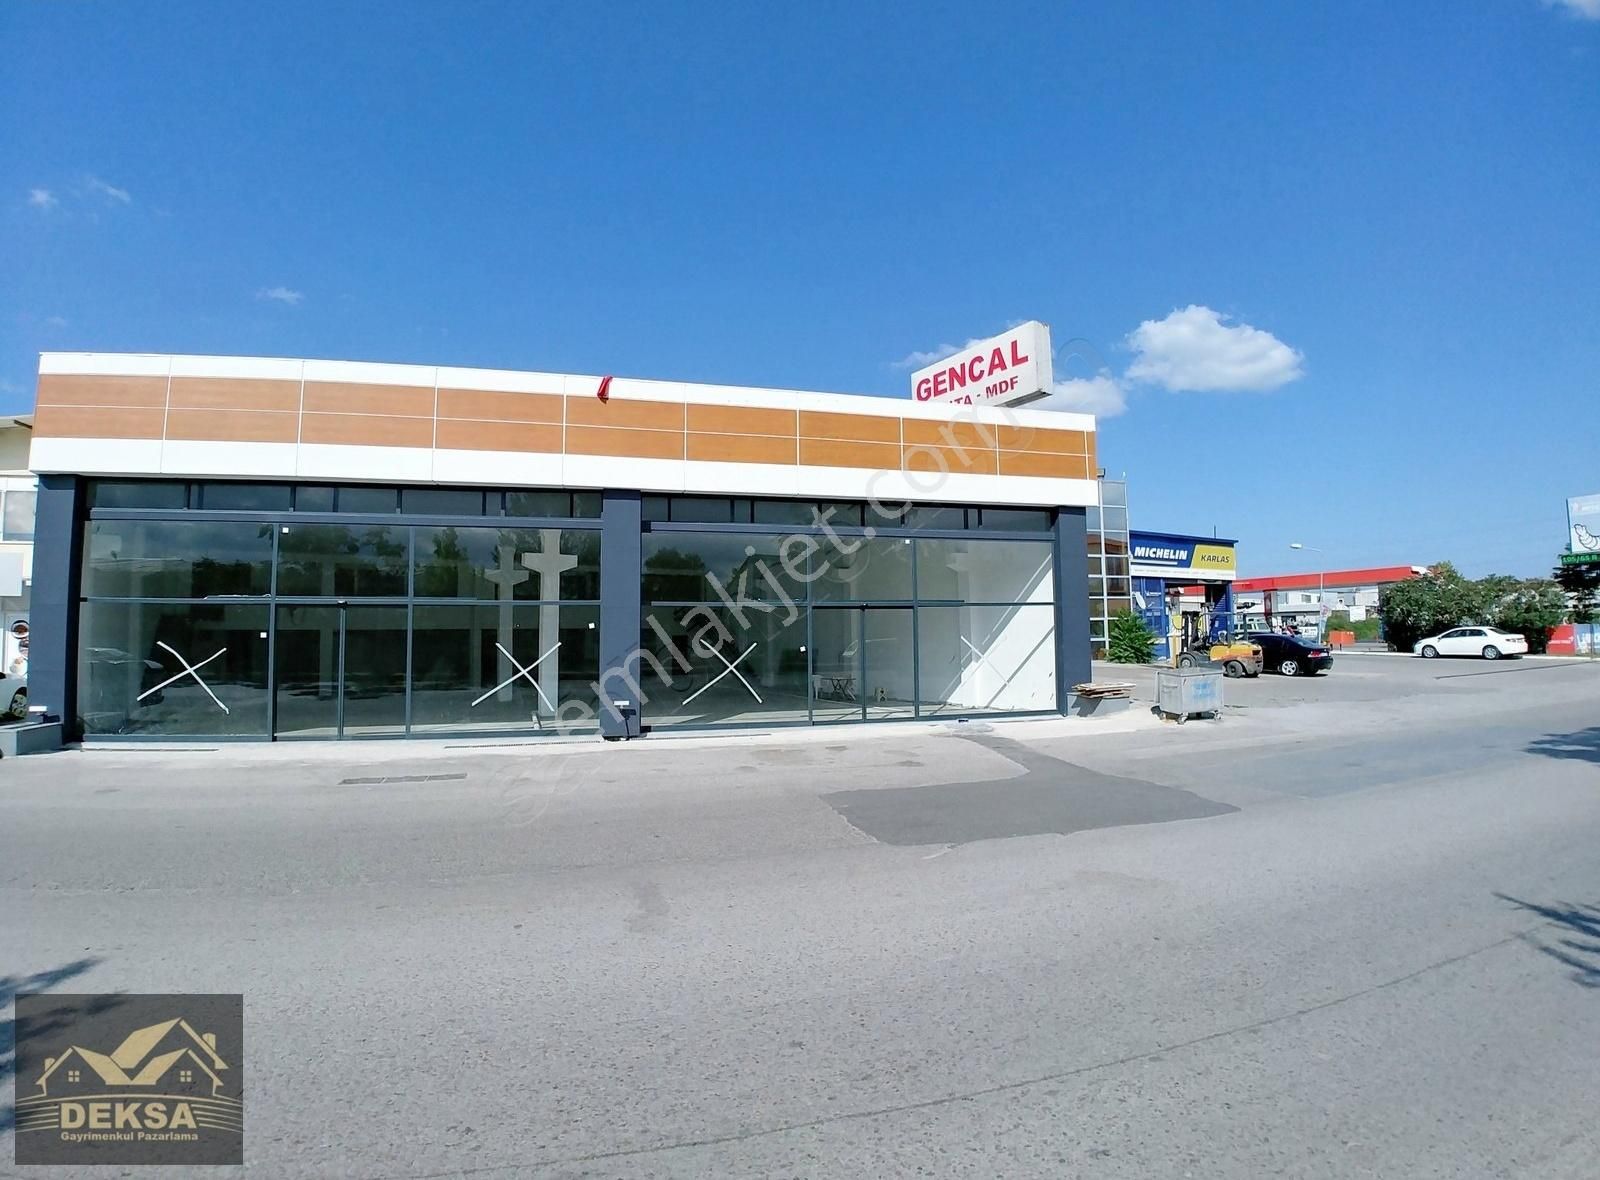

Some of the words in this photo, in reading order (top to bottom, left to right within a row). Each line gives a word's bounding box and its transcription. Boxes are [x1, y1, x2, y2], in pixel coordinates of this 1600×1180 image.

[916, 339, 1029, 401] GENCAL
[985, 376, 1019, 399] MDF
[1134, 546, 1188, 560] MICHELIN
[1201, 554, 1230, 563] KARLAS
